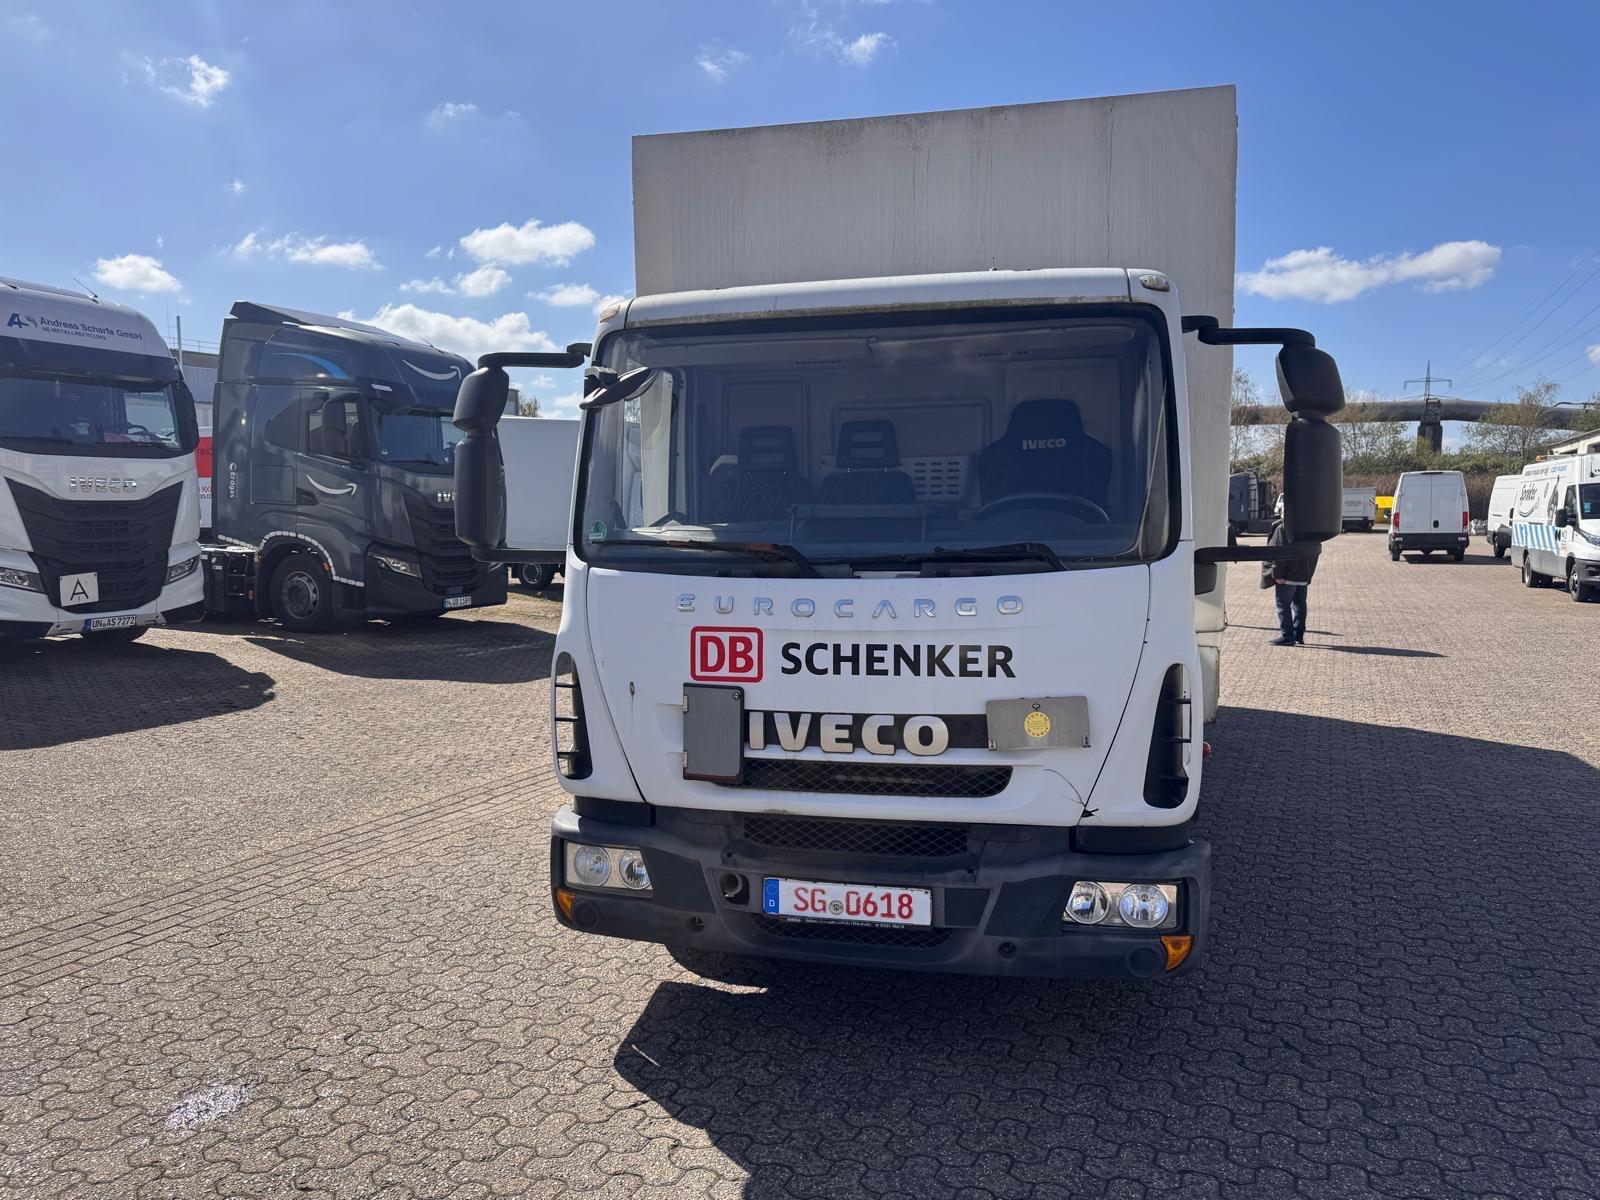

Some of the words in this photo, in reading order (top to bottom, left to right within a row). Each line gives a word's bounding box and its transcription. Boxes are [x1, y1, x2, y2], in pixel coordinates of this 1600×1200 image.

[40, 317, 79, 330] Andreas
[81, 323, 115, 336] Scharfe
[116, 329, 143, 341] GmbH
[1022, 438, 1067, 450] IVECO
[69, 477, 138, 494] IVECO
[228, 472, 236, 498] Erdgas
[70, 577, 90, 602] A
[676, 593, 1024, 619] EUROCARGO
[107, 617, 117, 627] AS
[118, 615, 135, 626] 7272
[699, 635, 755, 675] DB
[780, 642, 1017, 678] SCHENKER
[748, 711, 950, 756] IVECO
[768, 899, 775, 907] D
[793, 887, 827, 913] SG
[845, 891, 914, 920] 0618
